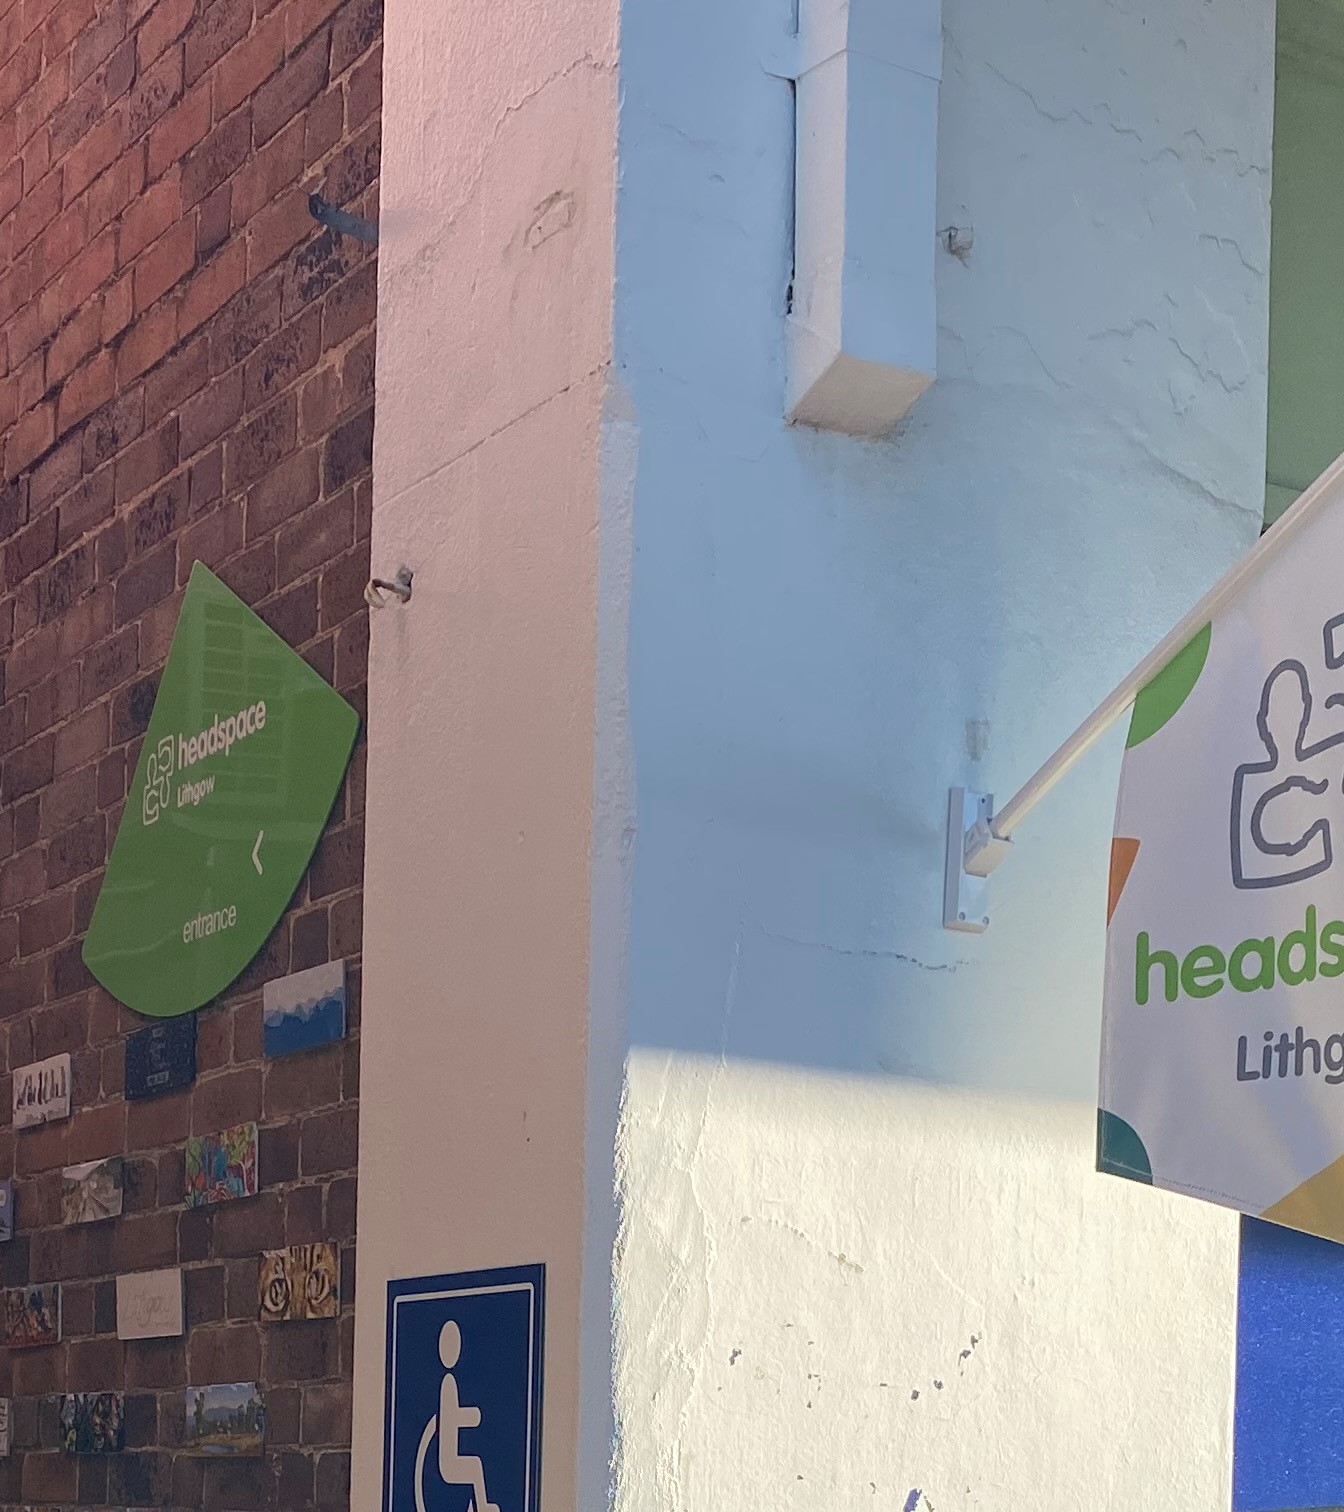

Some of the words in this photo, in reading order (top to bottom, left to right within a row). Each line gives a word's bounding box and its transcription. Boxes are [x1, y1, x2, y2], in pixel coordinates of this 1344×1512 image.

[178, 700, 267, 770] headspace
[177, 775, 216, 808] Lithgow
[183, 905, 237, 943] entrance
